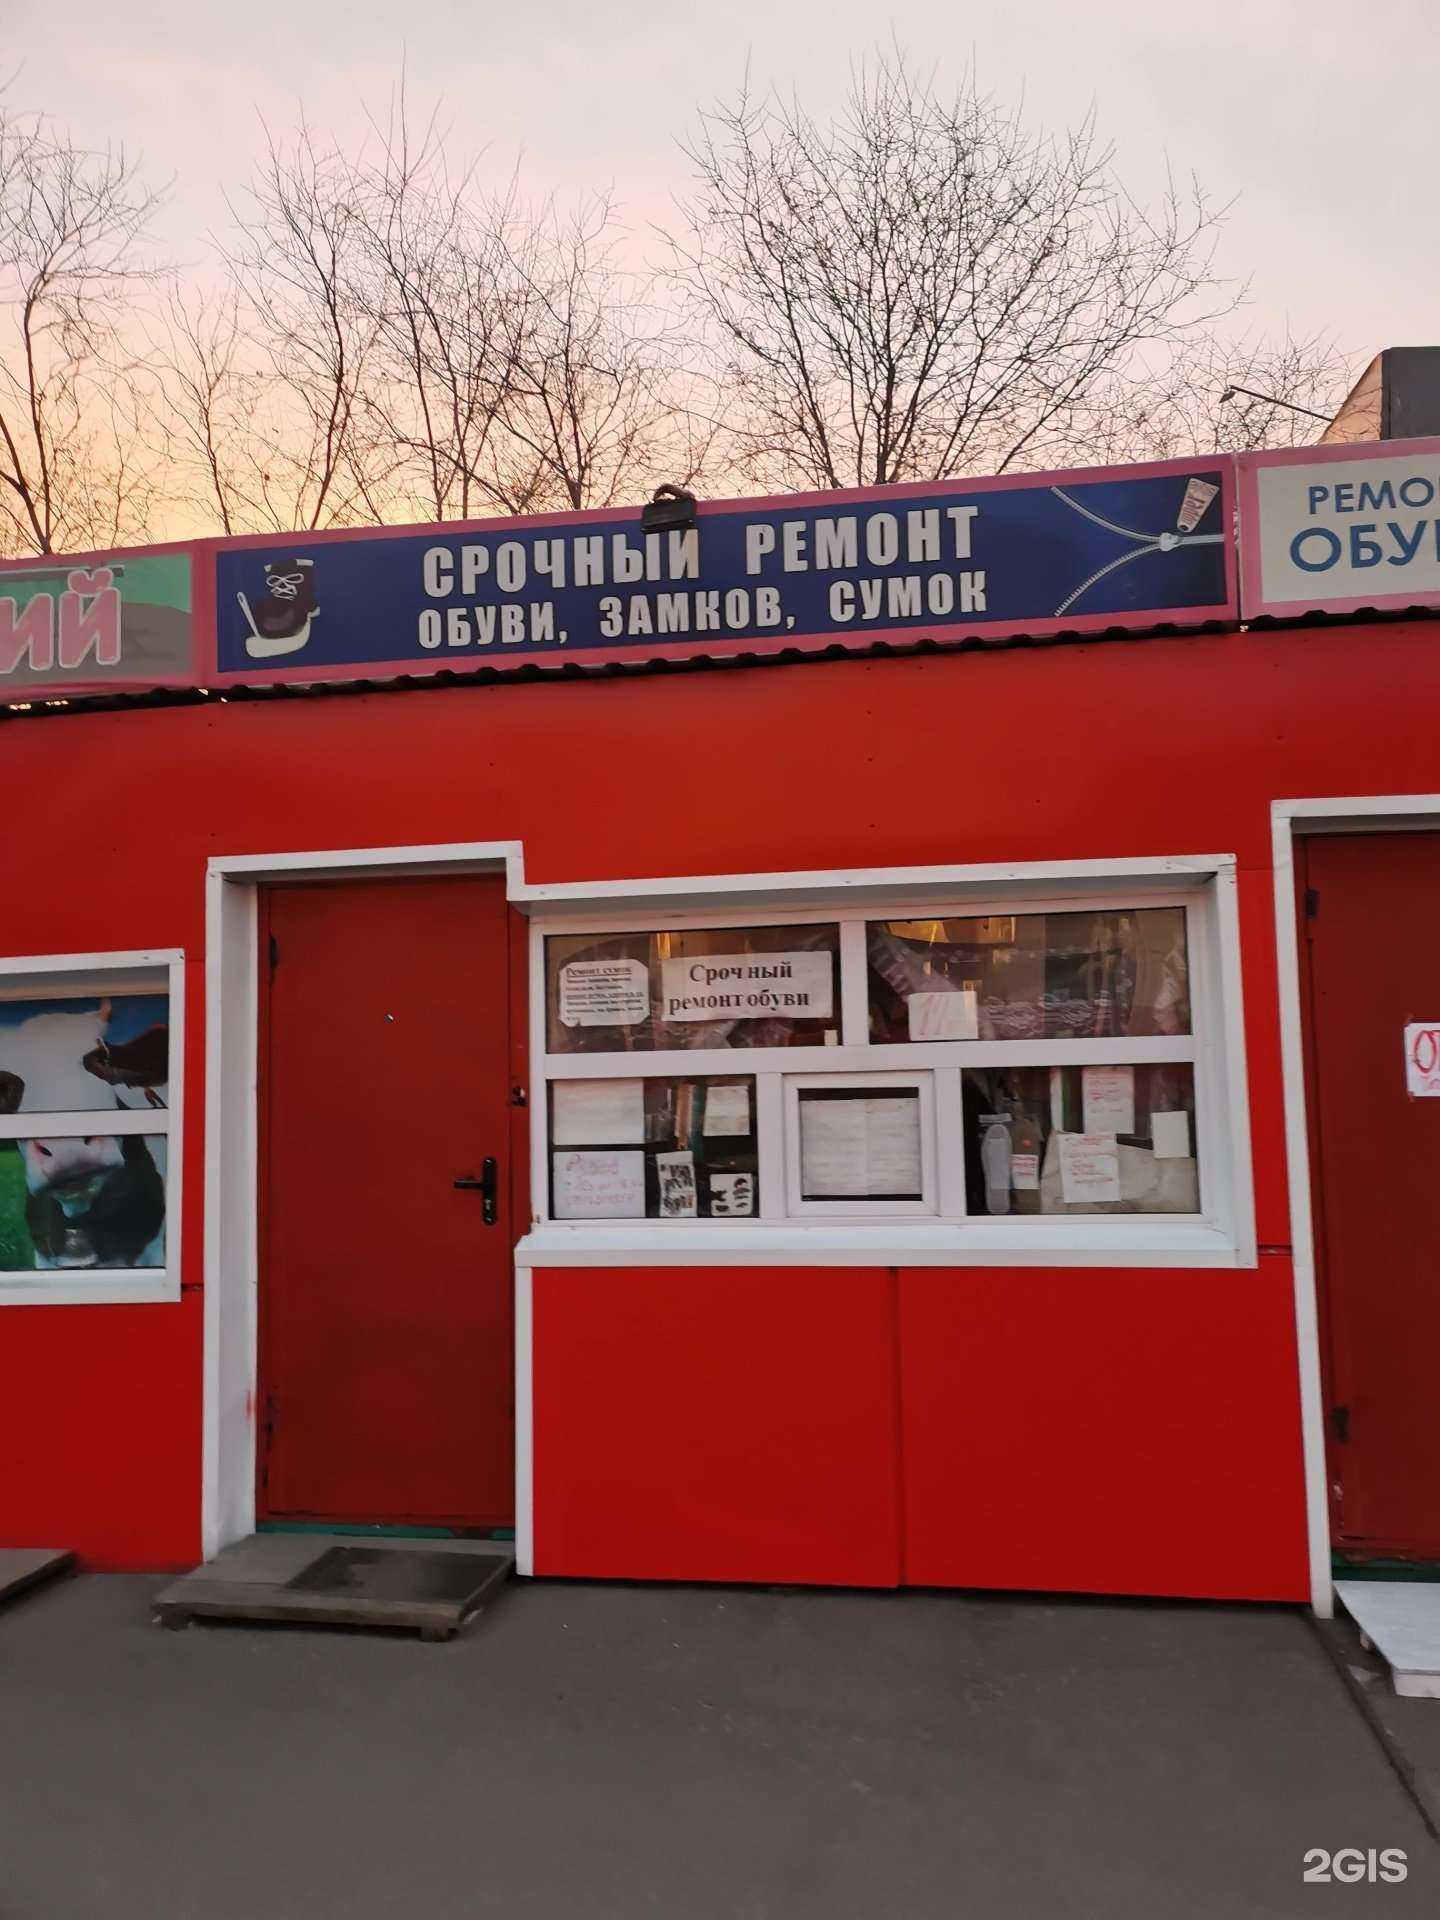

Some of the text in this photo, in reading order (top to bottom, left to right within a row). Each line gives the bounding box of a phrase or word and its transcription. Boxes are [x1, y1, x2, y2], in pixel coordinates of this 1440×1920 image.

[1308, 477, 1440, 515] РЕМО
[746, 506, 978, 575] РЕМОНТ
[418, 571, 986, 649] ОБУВИ, ЗАМКОВ, СУМОК
[669, 989, 809, 1015] ремонт обуви
